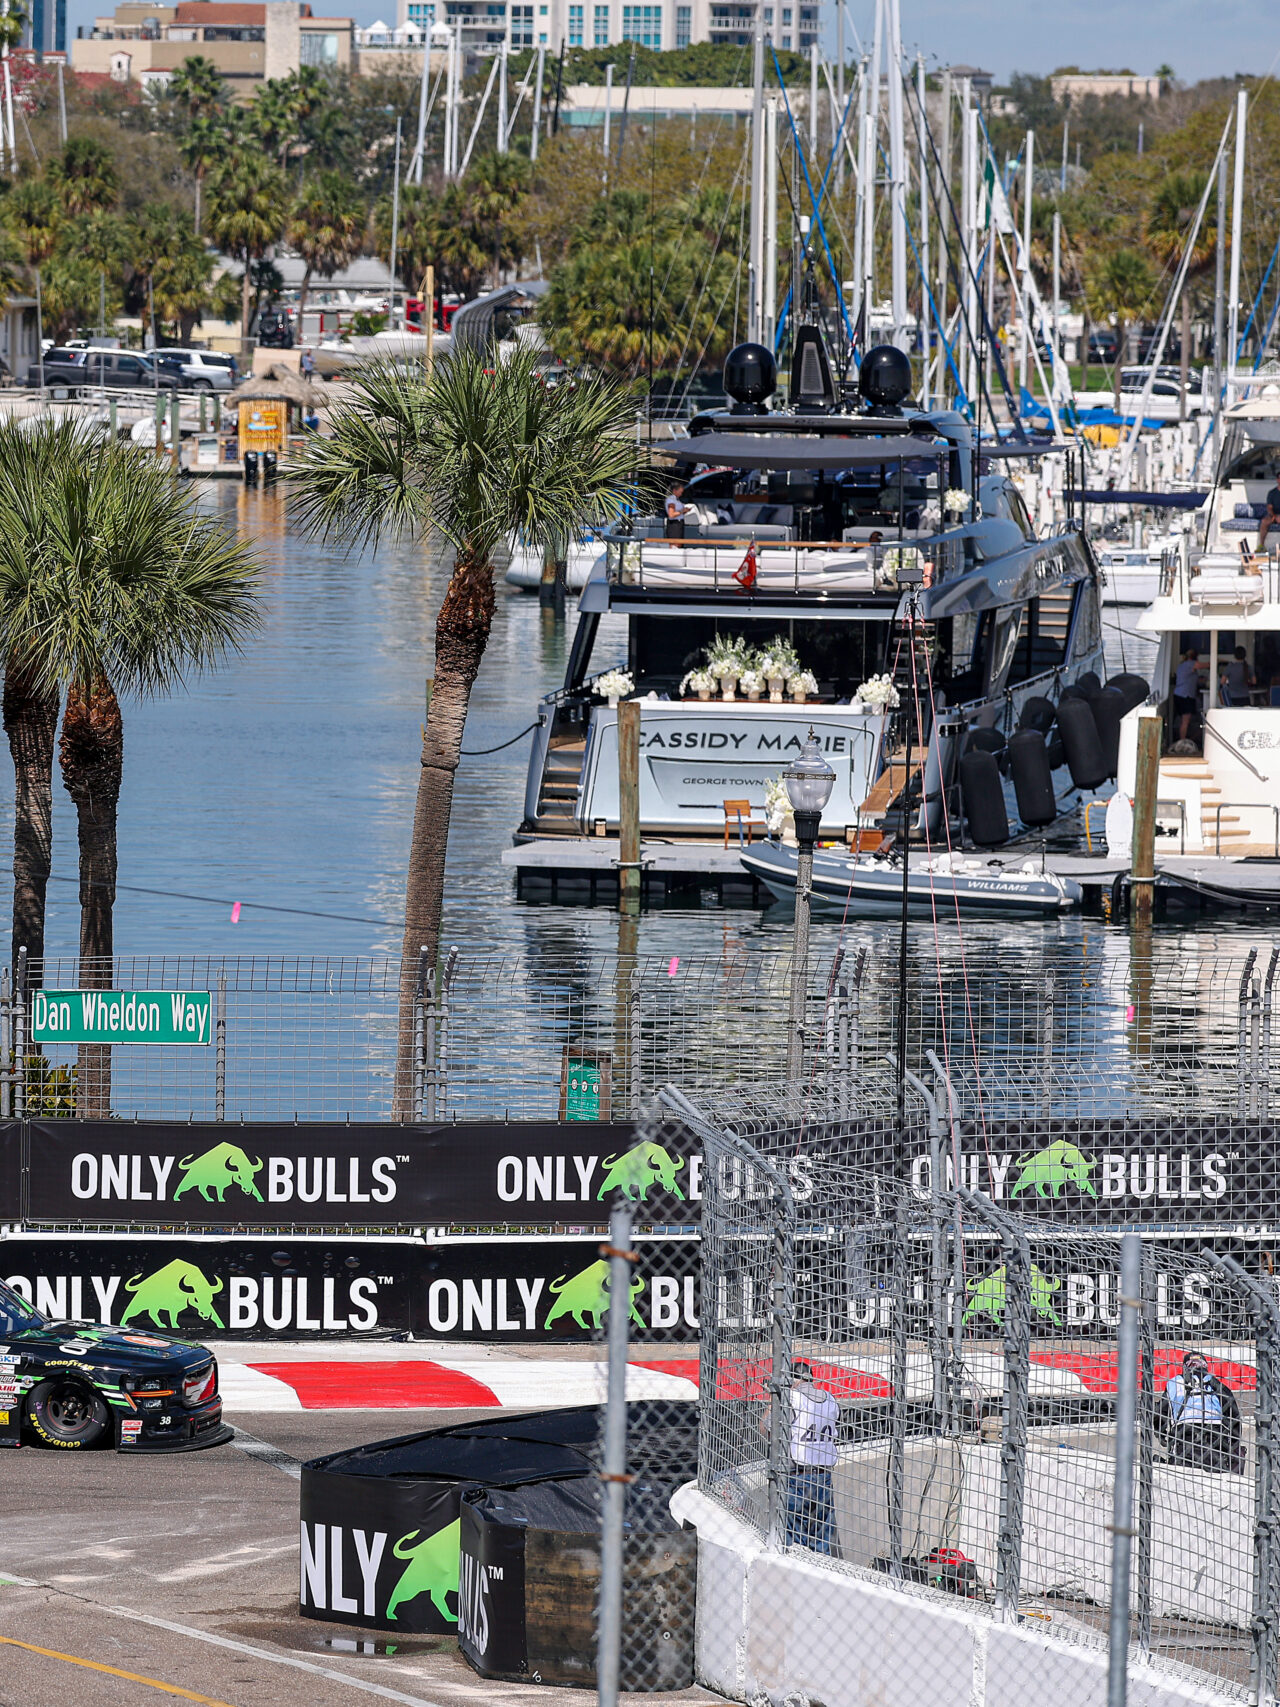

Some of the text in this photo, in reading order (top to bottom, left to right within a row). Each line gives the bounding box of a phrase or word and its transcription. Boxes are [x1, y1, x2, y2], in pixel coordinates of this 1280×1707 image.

[682, 777, 727, 786] GEORGE
[729, 777, 763, 787] TOWN
[967, 880, 1029, 892] WILLIAMS
[35, 992, 208, 1042] Dan Wheldon Way
[71, 1152, 176, 1201] ONLY
[497, 1155, 599, 1202] ONLY
[428, 1276, 545, 1332] ONLY
[159, 1415, 172, 1426] 38
